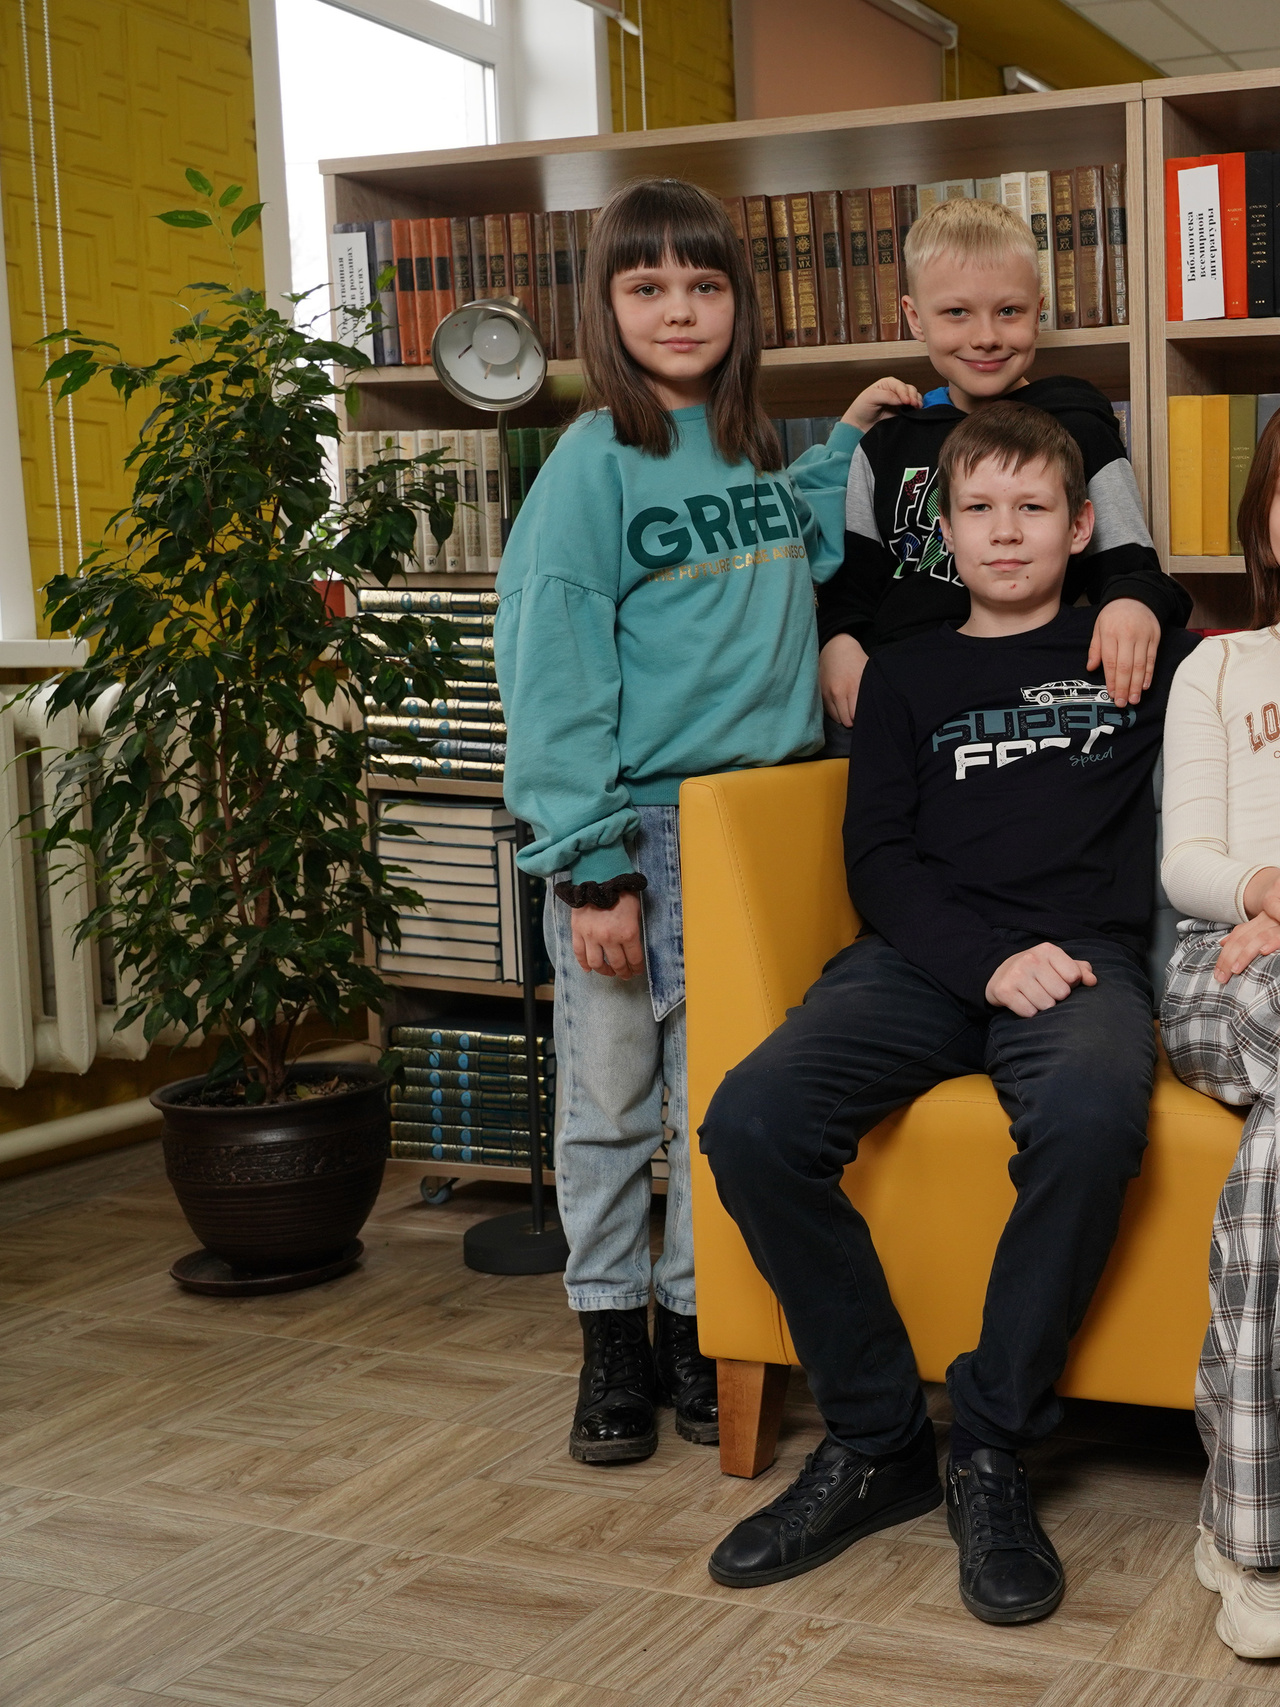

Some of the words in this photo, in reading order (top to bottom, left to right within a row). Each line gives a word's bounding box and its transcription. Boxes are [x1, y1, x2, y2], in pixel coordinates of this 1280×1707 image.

[347, 246, 357, 291] романах
[1187, 211, 1196, 282] Библиотека
[1196, 212, 1207, 278] всемирной
[1208, 208, 1218, 281] литературы
[679, 557, 731, 580] FUTURE
[732, 552, 755, 570] CA
[772, 544, 806, 561] AWESO
[1069, 688, 1078, 697] 14
